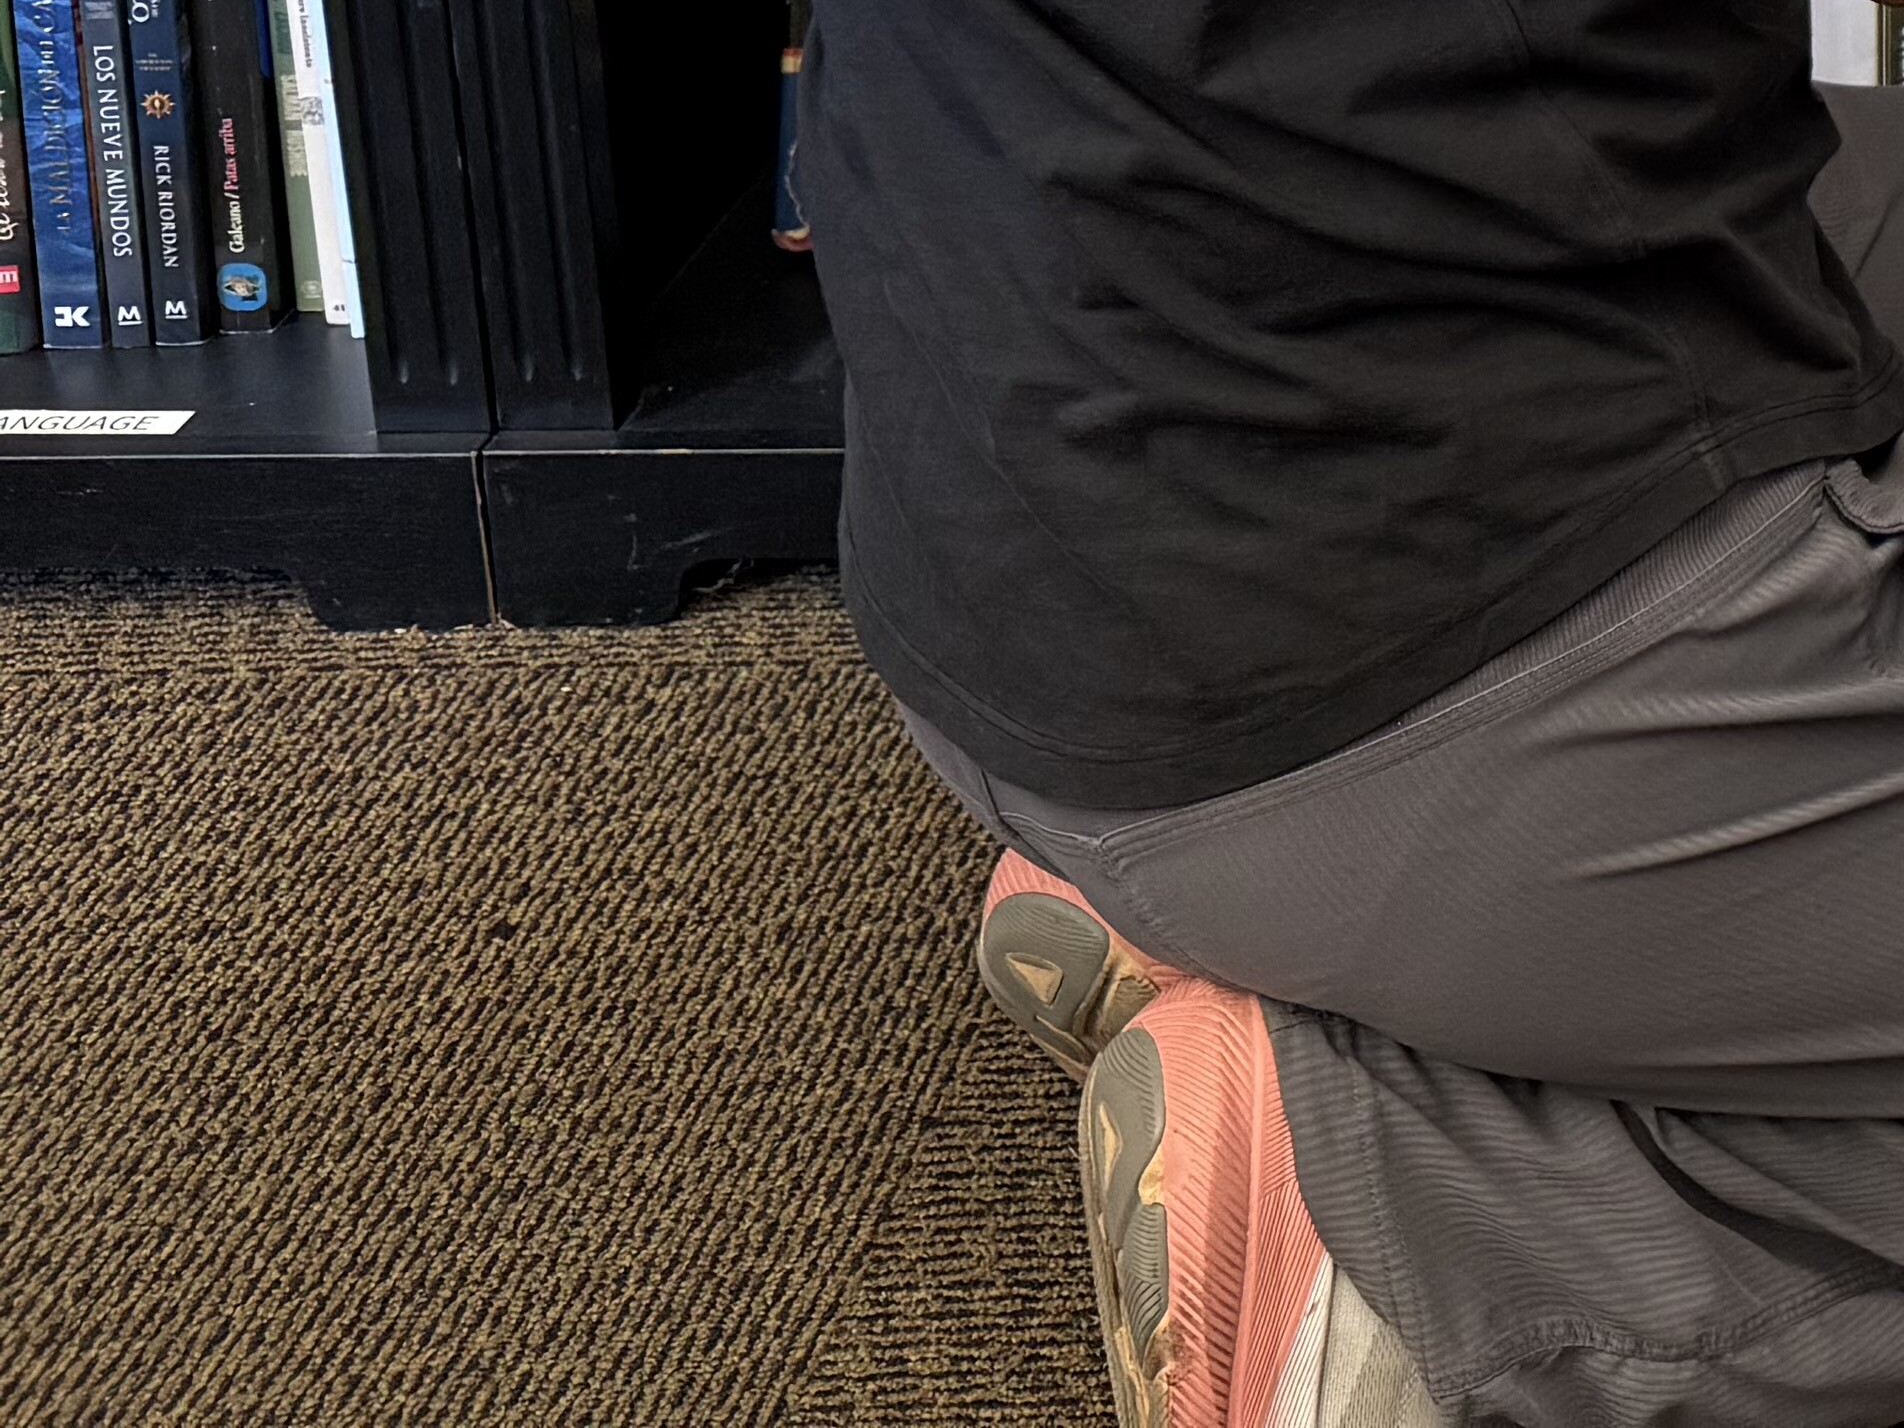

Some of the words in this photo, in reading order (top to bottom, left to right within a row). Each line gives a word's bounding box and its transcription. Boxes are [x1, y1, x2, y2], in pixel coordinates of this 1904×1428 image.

[93, 45, 115, 82] LOS
[95, 88, 124, 160] NUEVE
[224, 117, 234, 154] arriba
[153, 144, 172, 181] RICK
[223, 157, 238, 192] Patas
[104, 167, 133, 258] MUNDOS
[157, 189, 180, 269] RIORDAN
[229, 202, 246, 254] Galeano
